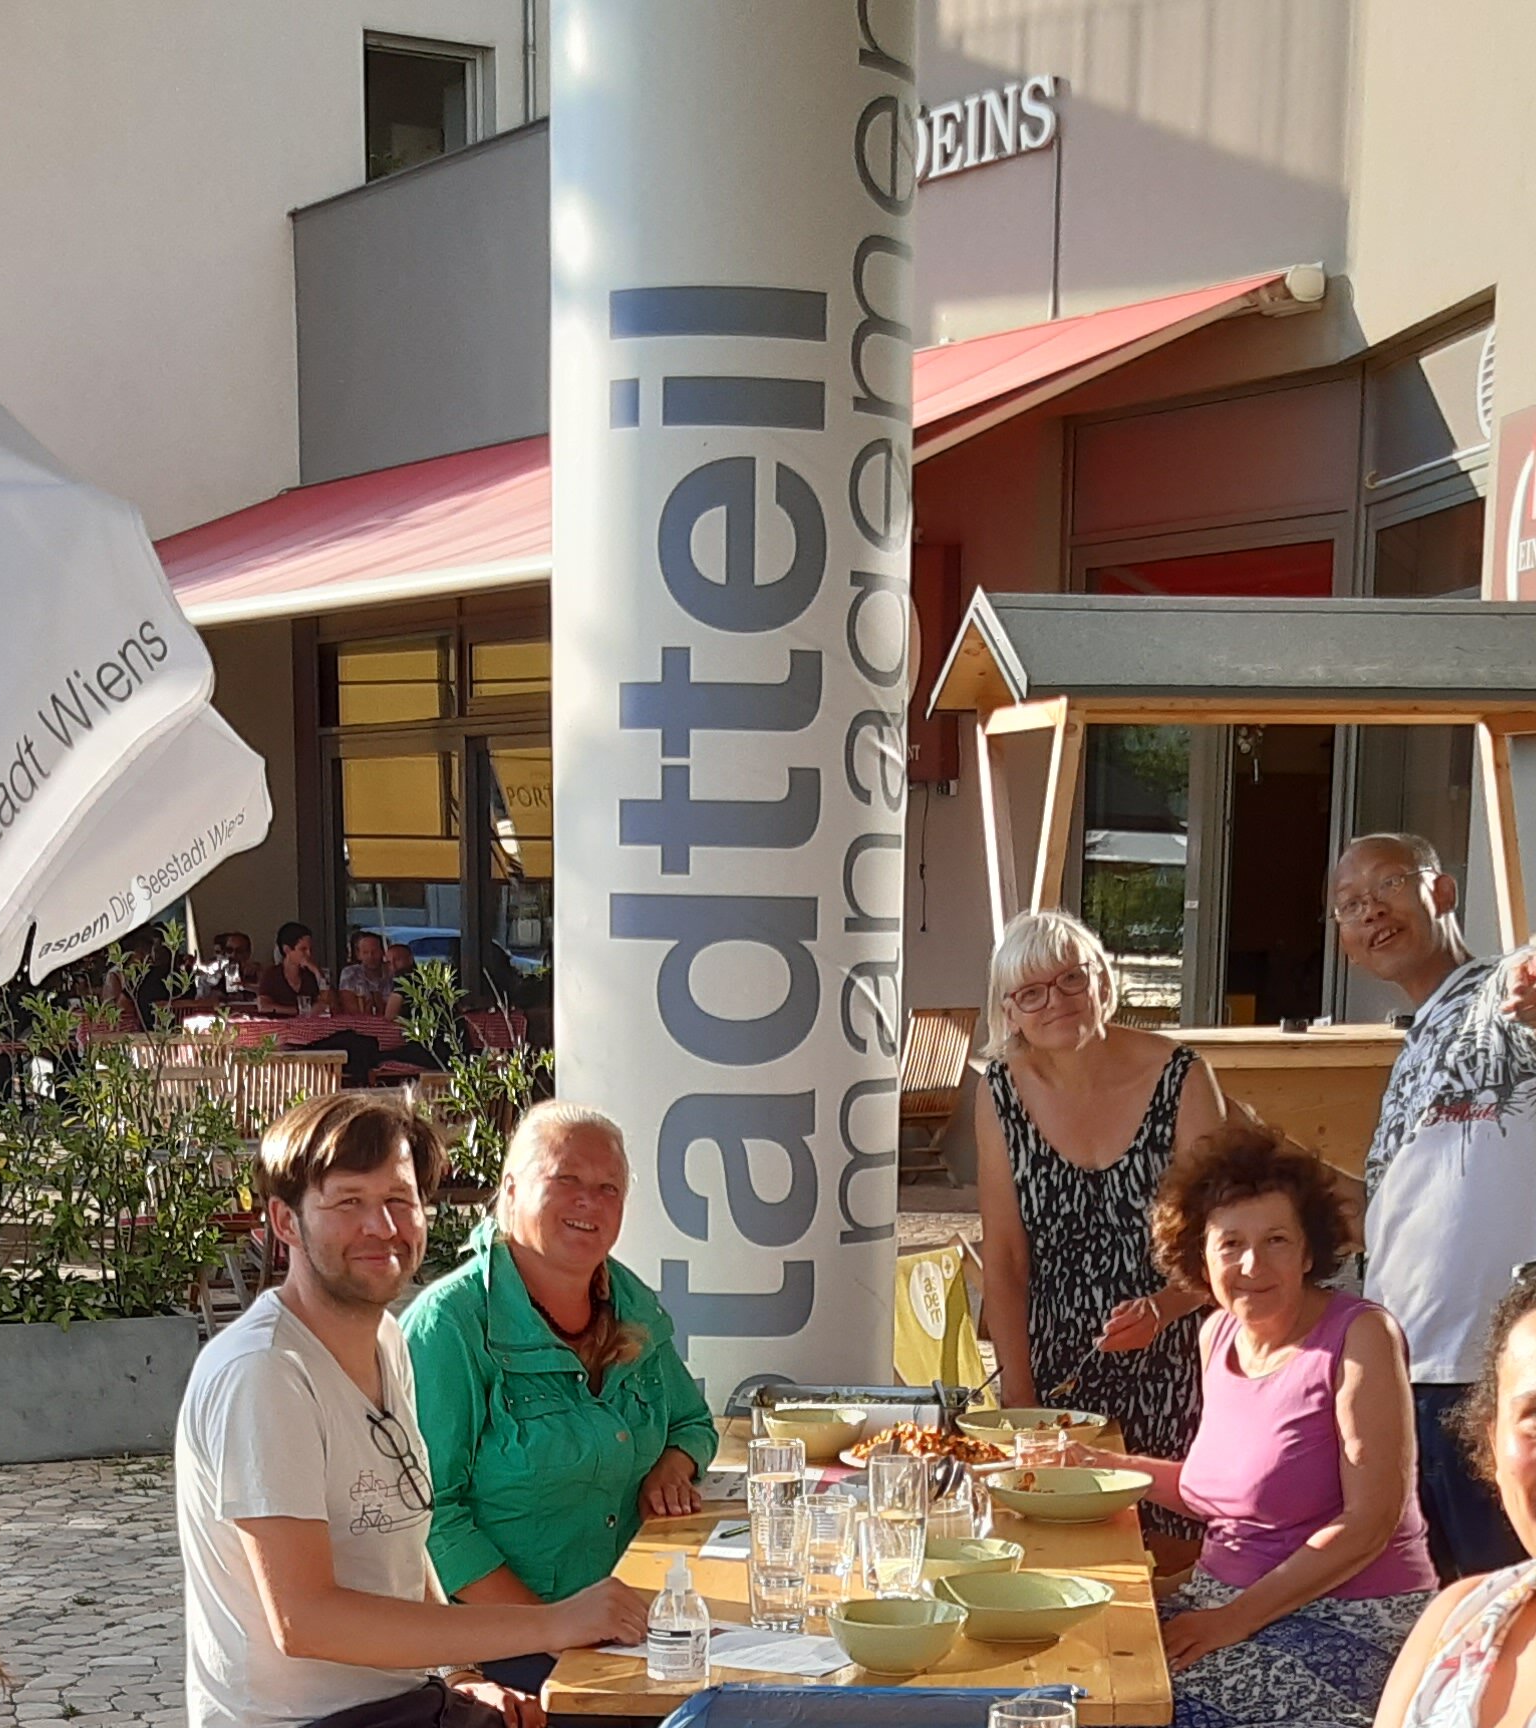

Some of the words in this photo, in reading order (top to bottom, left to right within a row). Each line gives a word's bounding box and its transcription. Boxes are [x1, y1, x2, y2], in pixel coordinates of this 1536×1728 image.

[915, 73, 1056, 185] EINS
[37, 620, 168, 750] Wiens
[38, 911, 110, 960] aspern
[109, 889, 137, 924] Die
[136, 838, 208, 901] Seestadt
